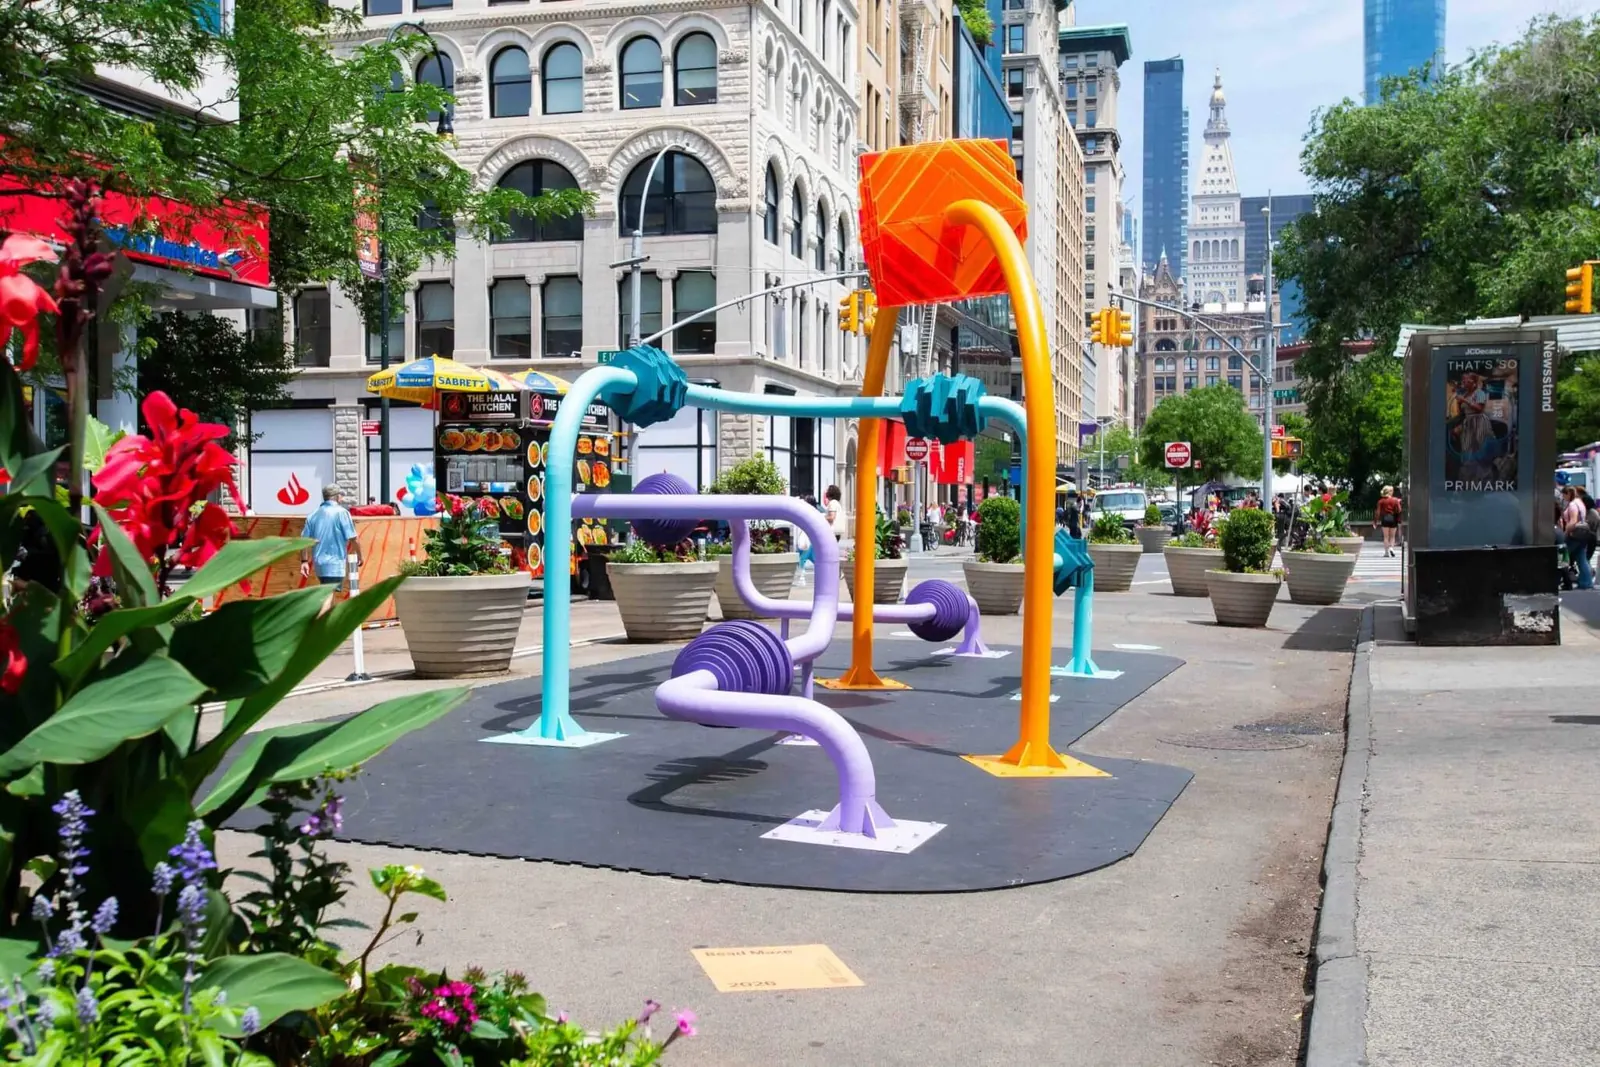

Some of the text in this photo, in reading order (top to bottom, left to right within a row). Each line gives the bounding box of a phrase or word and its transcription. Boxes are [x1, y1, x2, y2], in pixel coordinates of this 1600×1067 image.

[602, 353, 607, 362] E
[1448, 360, 1493, 371] THAT'S
[1542, 340, 1556, 412] Newsstand
[438, 377, 485, 388] SABRETT
[467, 394, 517, 403] THE HALAL
[472, 402, 512, 412] KITCHEN
[543, 399, 558, 411] THE
[1444, 480, 1515, 491] PRIMARK
